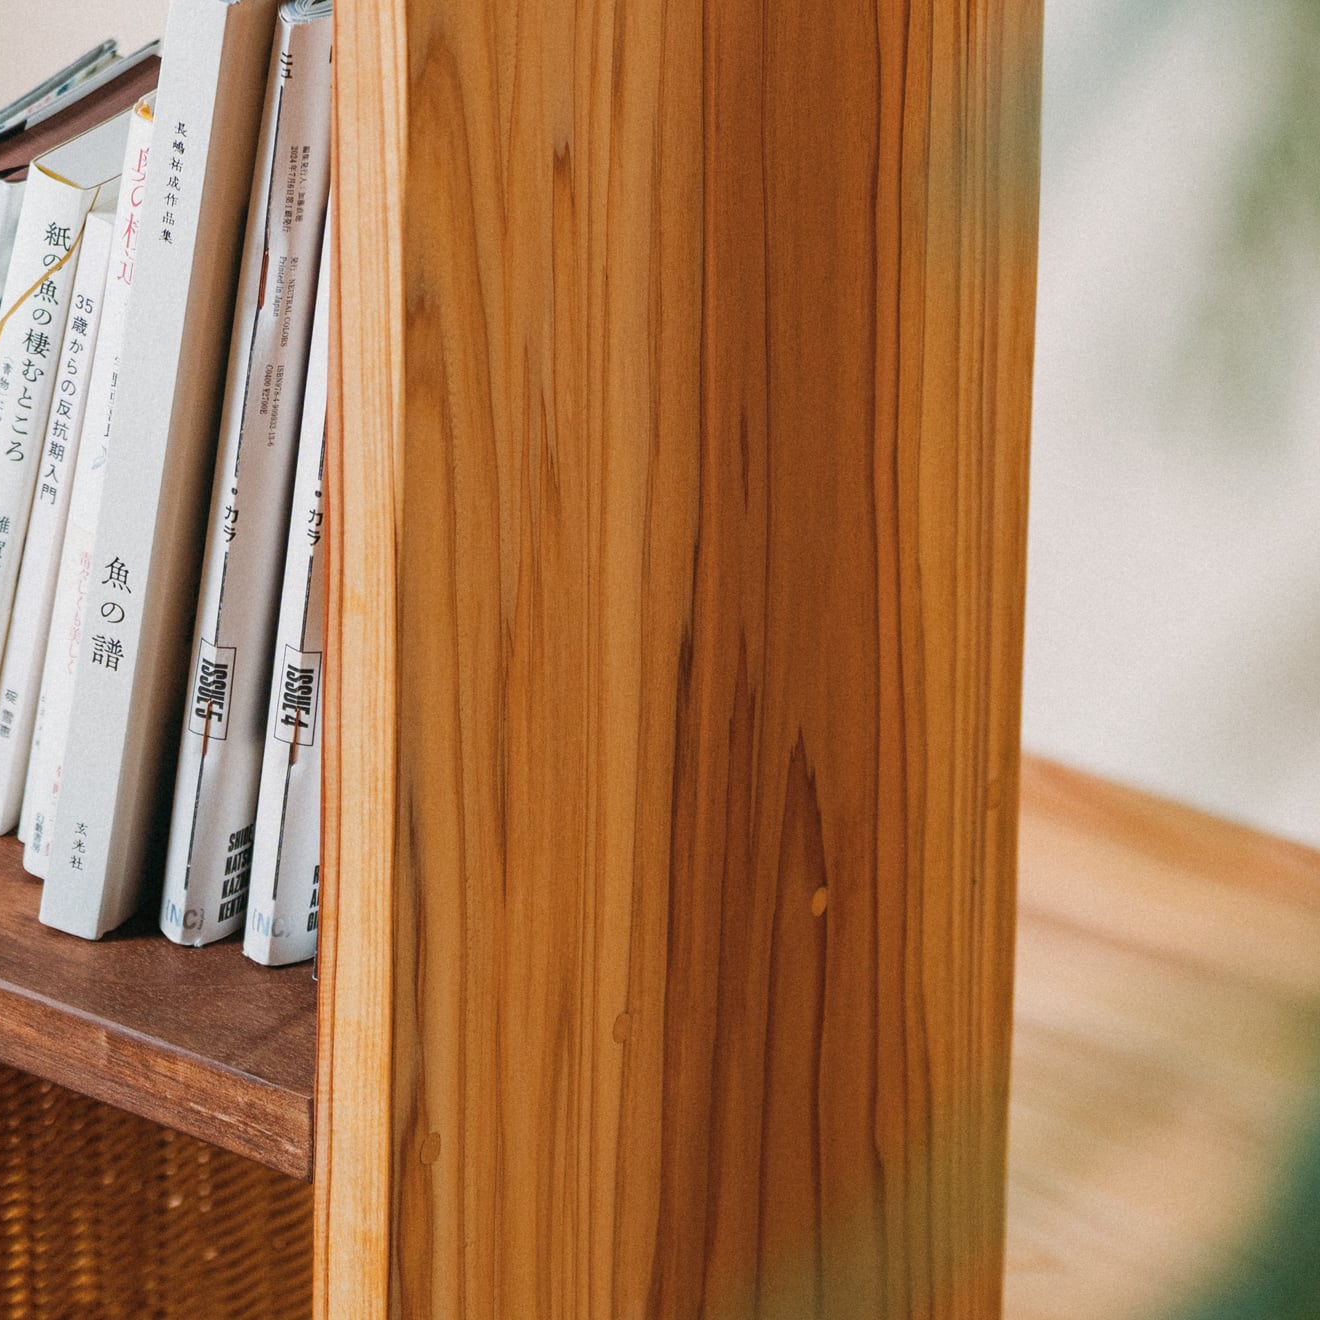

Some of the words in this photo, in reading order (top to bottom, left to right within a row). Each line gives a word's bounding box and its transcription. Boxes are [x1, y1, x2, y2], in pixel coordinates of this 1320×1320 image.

[158, 120, 188, 245] 長嶋祐成作品集
[272, 294, 282, 318] Japan
[275, 255, 287, 285] Printed
[6, 221, 72, 462] 紙の魚の棲むところ
[40, 294, 95, 506] 35歳からの反抗期入門
[92, 555, 132, 672] 魚の譜
[68, 821, 88, 871] 玄光社
